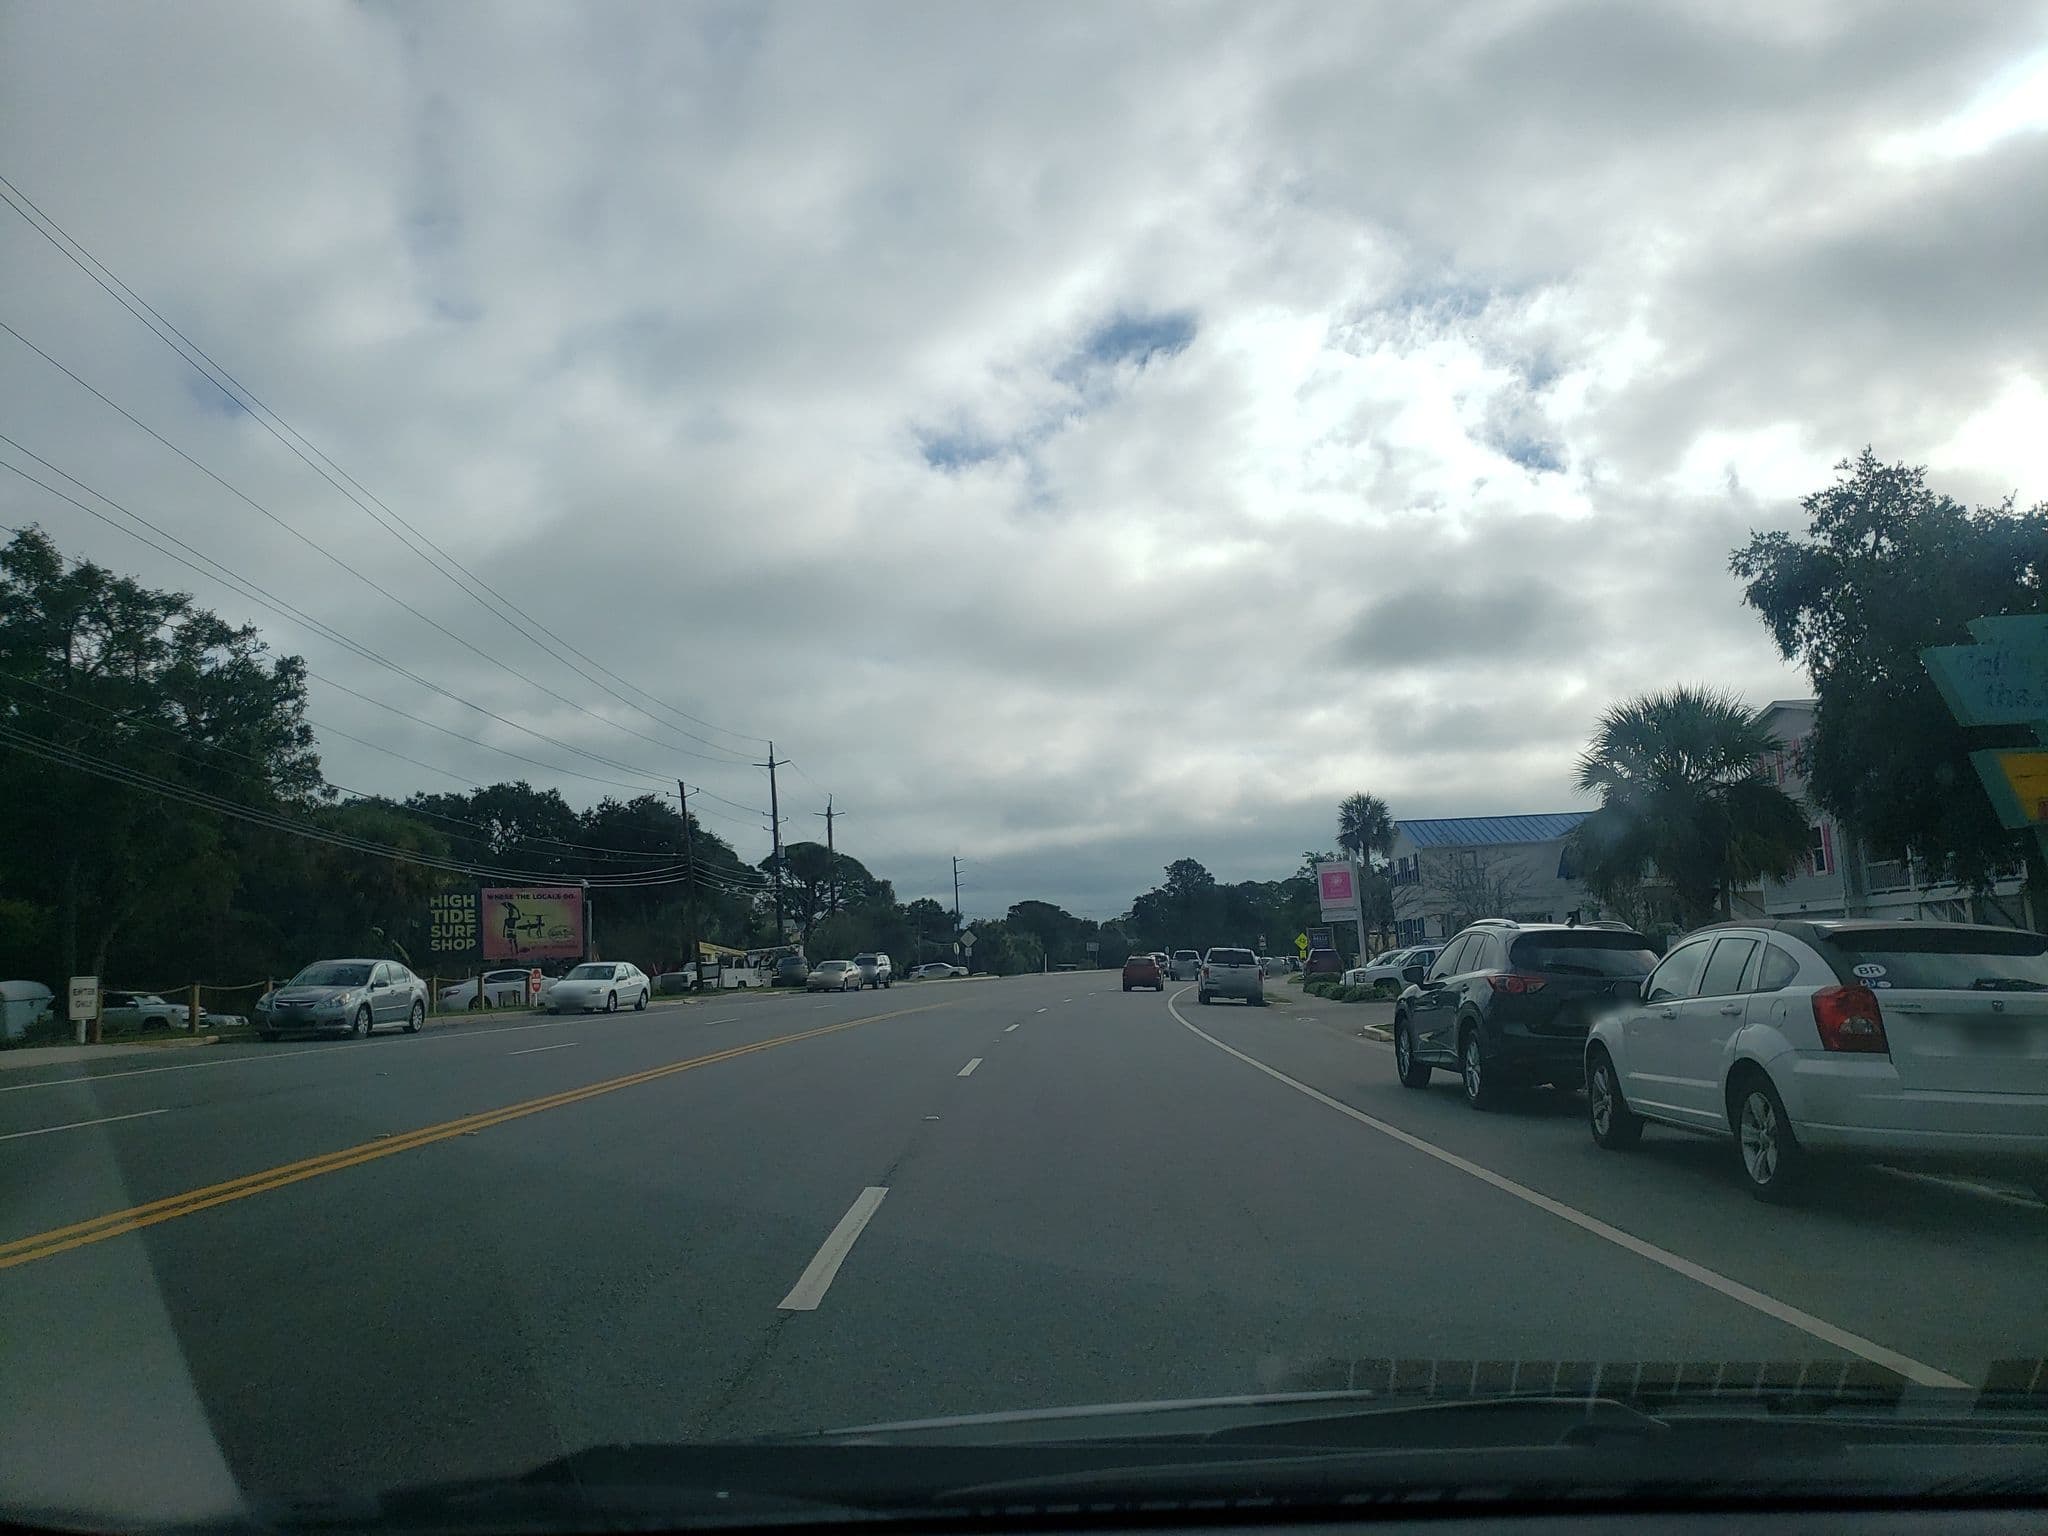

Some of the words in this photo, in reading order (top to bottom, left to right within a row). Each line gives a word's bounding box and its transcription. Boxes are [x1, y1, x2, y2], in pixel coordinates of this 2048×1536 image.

[431, 894, 475, 908] HIGH
[431, 908, 476, 924] TIDE
[431, 924, 476, 938] SURF
[431, 938, 476, 951] SHOP
[1858, 965, 1881, 975] BR
